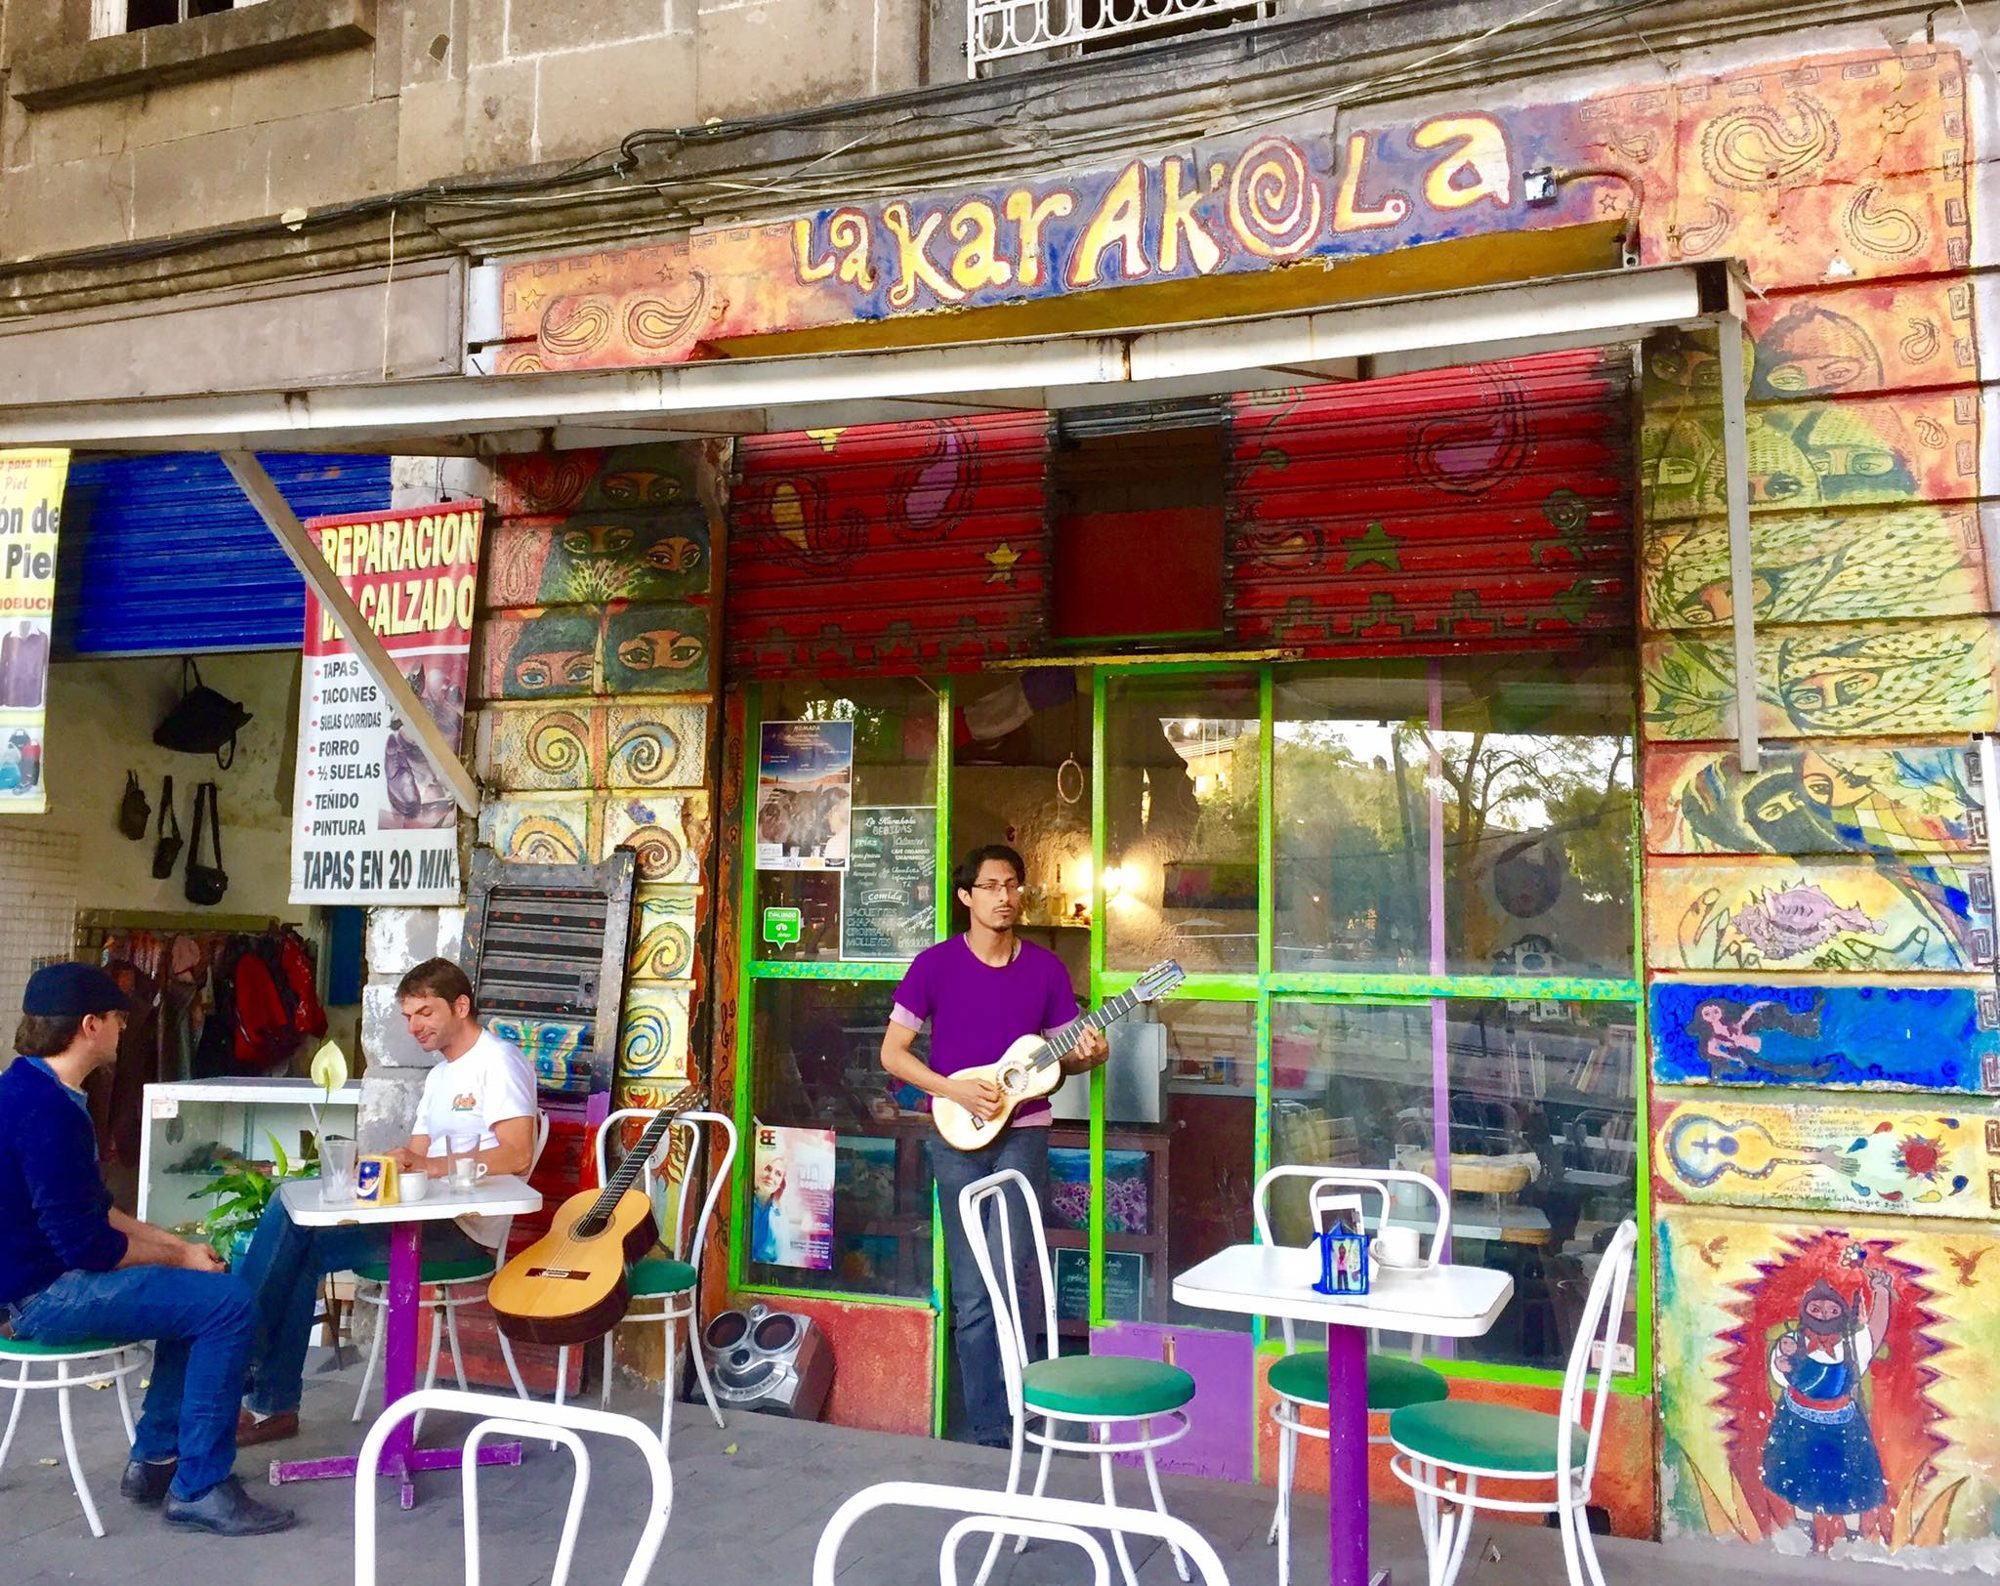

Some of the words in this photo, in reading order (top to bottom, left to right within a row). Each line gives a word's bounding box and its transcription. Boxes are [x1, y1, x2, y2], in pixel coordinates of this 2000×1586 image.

[5, 476, 28, 490] Piel
[321, 511, 481, 577] REPARACION
[5, 543, 58, 580] Piel
[360, 574, 475, 637] CALZADO
[323, 660, 359, 679] TAPAS
[322, 685, 377, 705] TACONES
[320, 713, 342, 731] SUELAS
[343, 711, 382, 729] CORRIDAS
[318, 739, 360, 757] FORRO
[329, 762, 381, 780] SUELAS
[312, 819, 366, 837] PINTURA
[303, 850, 355, 890] TAPAS
[359, 850, 383, 889] EN
[388, 849, 412, 889] 20
